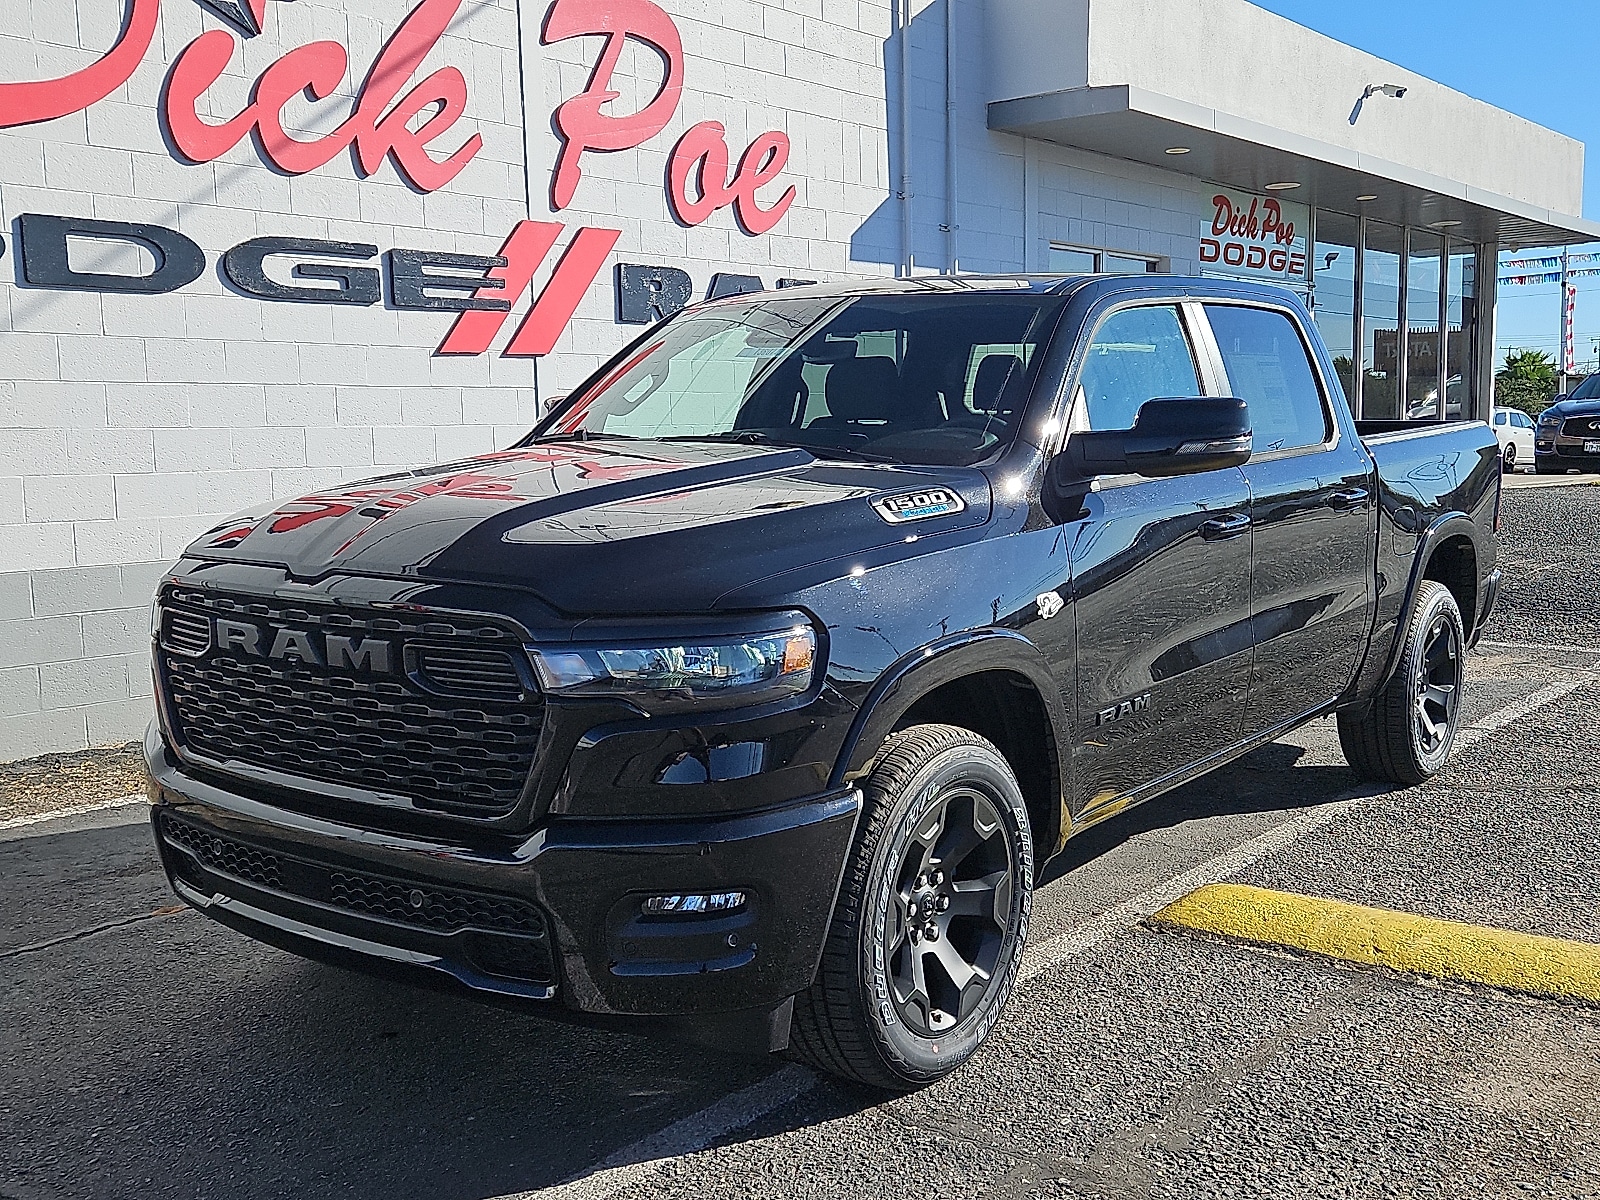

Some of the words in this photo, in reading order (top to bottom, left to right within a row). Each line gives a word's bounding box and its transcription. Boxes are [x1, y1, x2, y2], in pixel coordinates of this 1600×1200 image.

[0, 0, 484, 194] ick
[541, 0, 797, 236] Poe
[1211, 194, 1259, 241] Dick
[1260, 197, 1295, 246] Poe
[0, 213, 512, 311] DGE
[1199, 238, 1306, 275] DODGE
[885, 491, 949, 511] 1500
[215, 618, 392, 673] RAM
[1095, 693, 1152, 727] RAM
